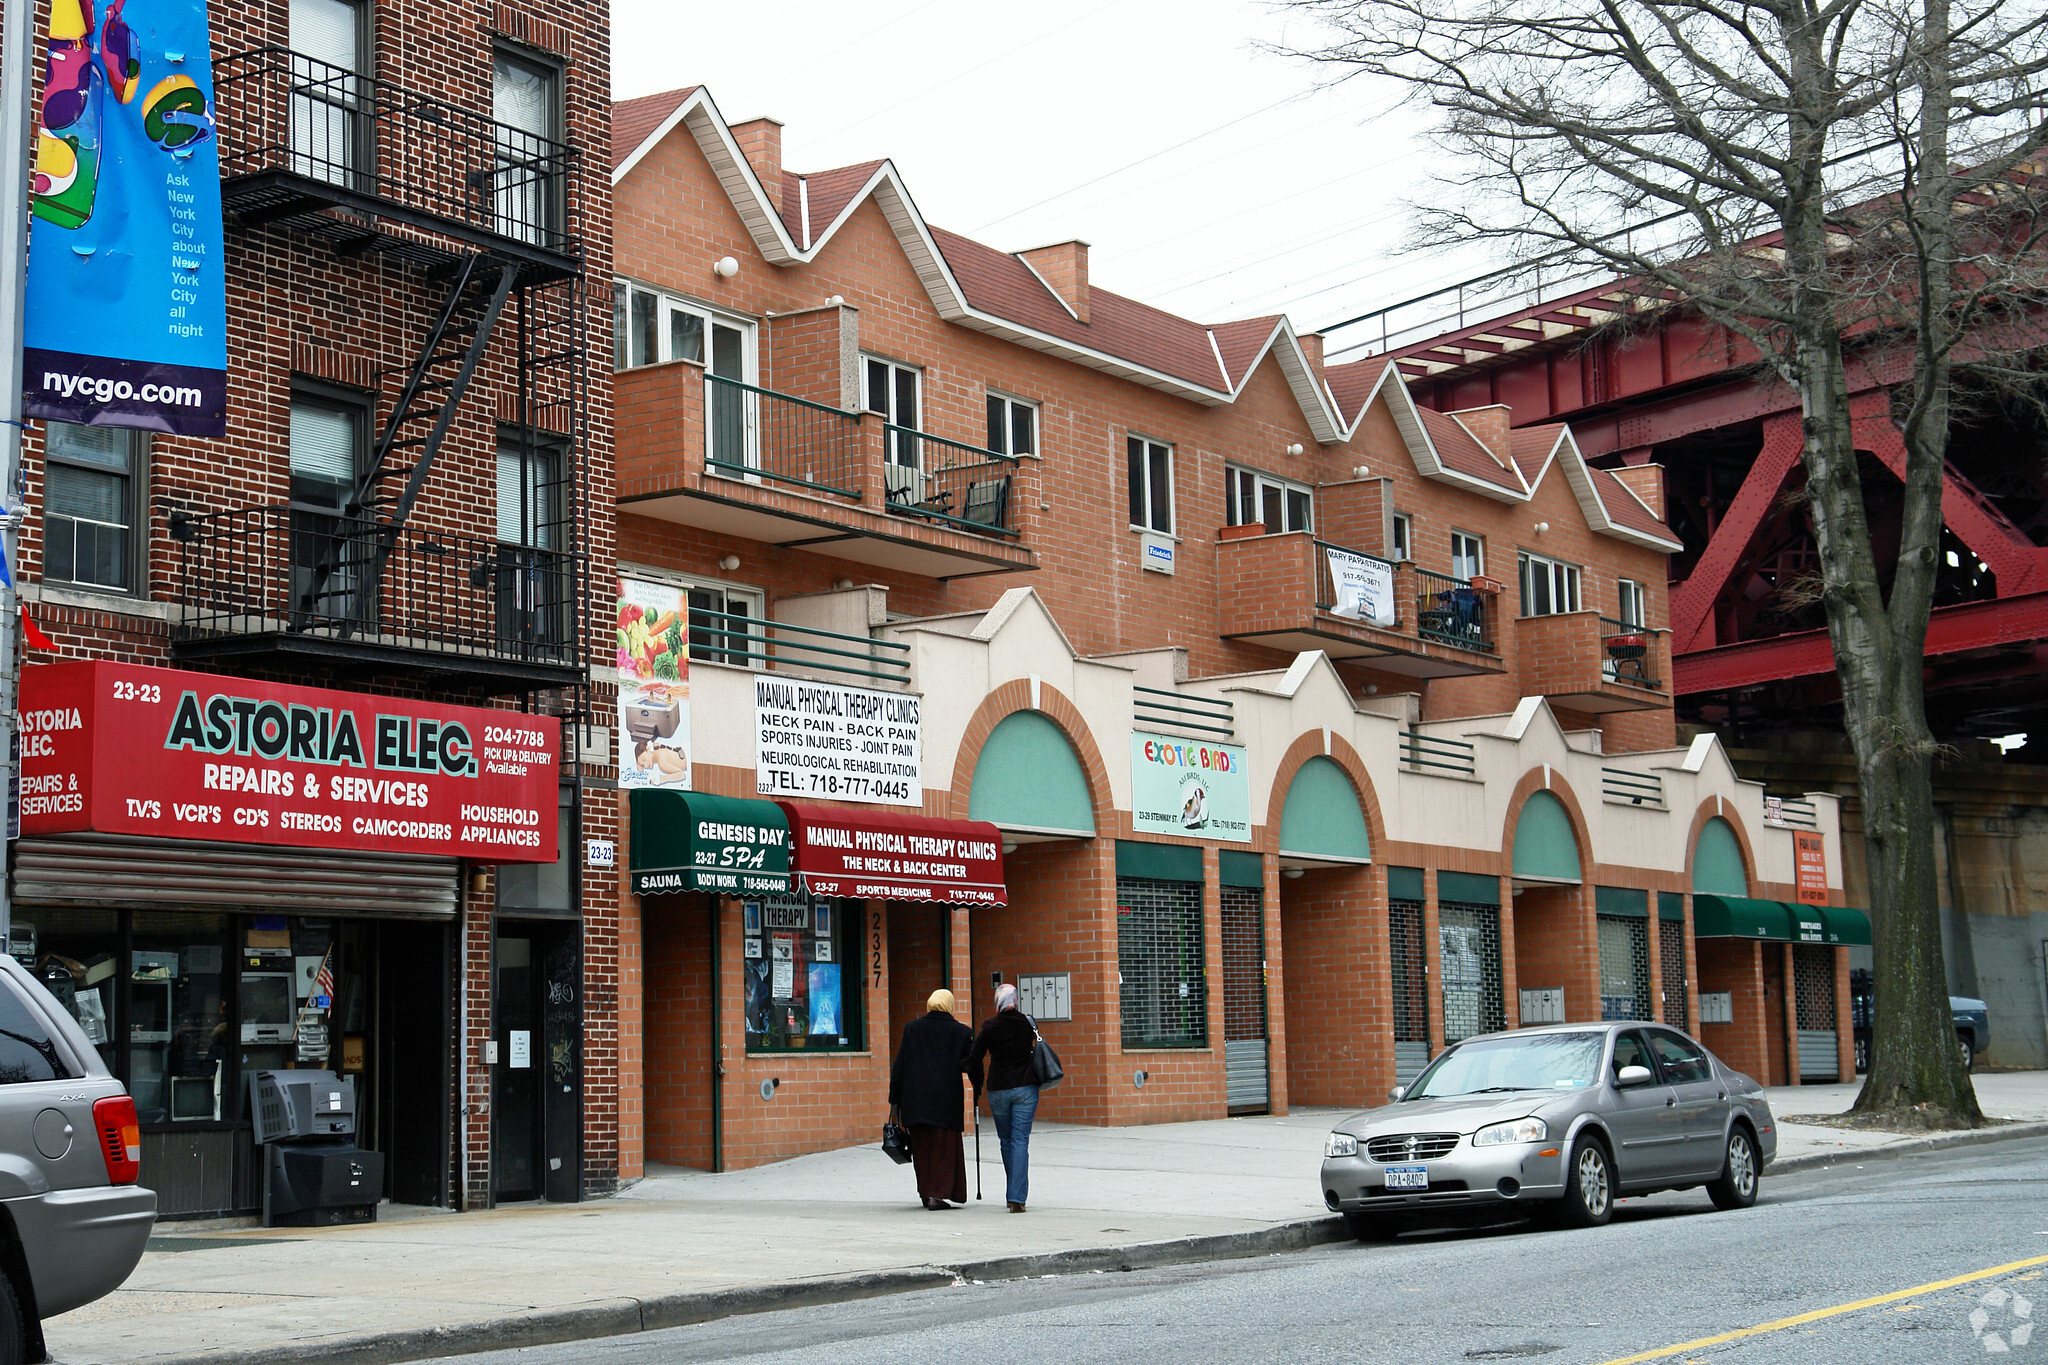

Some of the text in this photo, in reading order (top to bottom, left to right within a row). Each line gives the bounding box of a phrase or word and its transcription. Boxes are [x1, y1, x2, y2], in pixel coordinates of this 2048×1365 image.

[166, 173, 190, 187] Ask
[167, 189, 195, 204] New
[169, 206, 196, 221] York
[172, 223, 194, 239] City
[172, 241, 206, 254] about
[172, 255, 199, 268] New
[171, 272, 199, 287] York
[171, 289, 197, 305] City
[170, 306, 186, 318] all
[169, 323, 203, 338] night
[43, 371, 202, 407] nycgo.com
[1327, 550, 1347, 561] MARY
[1348, 555, 1390, 574] PAPASTRATIS
[113, 681, 161, 704] 23-23
[757, 682, 919, 725] MANUAL PHYSICAL THERAPY CLINICS
[17, 707, 82, 733] ASTORIA
[761, 714, 800, 729] NECK
[804, 718, 834, 732] PAIN
[847, 723, 884, 738] BACK
[888, 727, 916, 741] PAIN
[164, 690, 479, 779] ASTORIA ELEC.
[484, 726, 545, 747] 204-7788
[761, 730, 803, 746] SPORTS
[806, 735, 852, 751] INJURIES
[861, 741, 889, 754] JOINT
[892, 743, 913, 757] PAIN
[484, 747, 502, 760] PICK
[519, 750, 552, 765] DELIVERY
[762, 751, 917, 777] NEUROLOGICAL REHABILITATION
[1144, 741, 1237, 773] EXOTIC BIRDS
[485, 761, 528, 776] Available
[20, 774, 63, 795] EPAIRS
[68, 773, 78, 791] &
[204, 763, 428, 808] REPAIRS & SERVICES
[758, 783, 773, 792] 2327
[768, 770, 909, 799] TEL: 718-777-0445
[22, 793, 83, 816] SERVICES
[461, 804, 539, 826] HOUSEHOLD
[173, 803, 221, 824] VCR'S
[233, 808, 269, 827] CD'S
[280, 811, 342, 833] STEREOS
[352, 817, 452, 841] CAMCORDERS
[1151, 812, 1171, 823] STEINWAY
[460, 825, 541, 847] APPLIANCES
[698, 821, 756, 844] GENESIS
[759, 827, 786, 846] DAY
[806, 826, 853, 849] MANUAL
[855, 830, 907, 854] PHYSICAL
[909, 835, 956, 858] THERAPY
[957, 841, 997, 861] CLINICS
[591, 846, 612, 860] 23-23
[695, 851, 717, 865] 23-27
[720, 846, 766, 869] SPA
[843, 855, 967, 878] THE NECK & BACK CENTER
[641, 874, 682, 888] SAUNA
[697, 873, 715, 886] BODY
[717, 874, 738, 888] WORK
[743, 876, 786, 892] 718-545-0449
[815, 882, 995, 901] 23-27 SPORTS MEDICINE 718-777-0445
[766, 908, 804, 926] THERAPY
